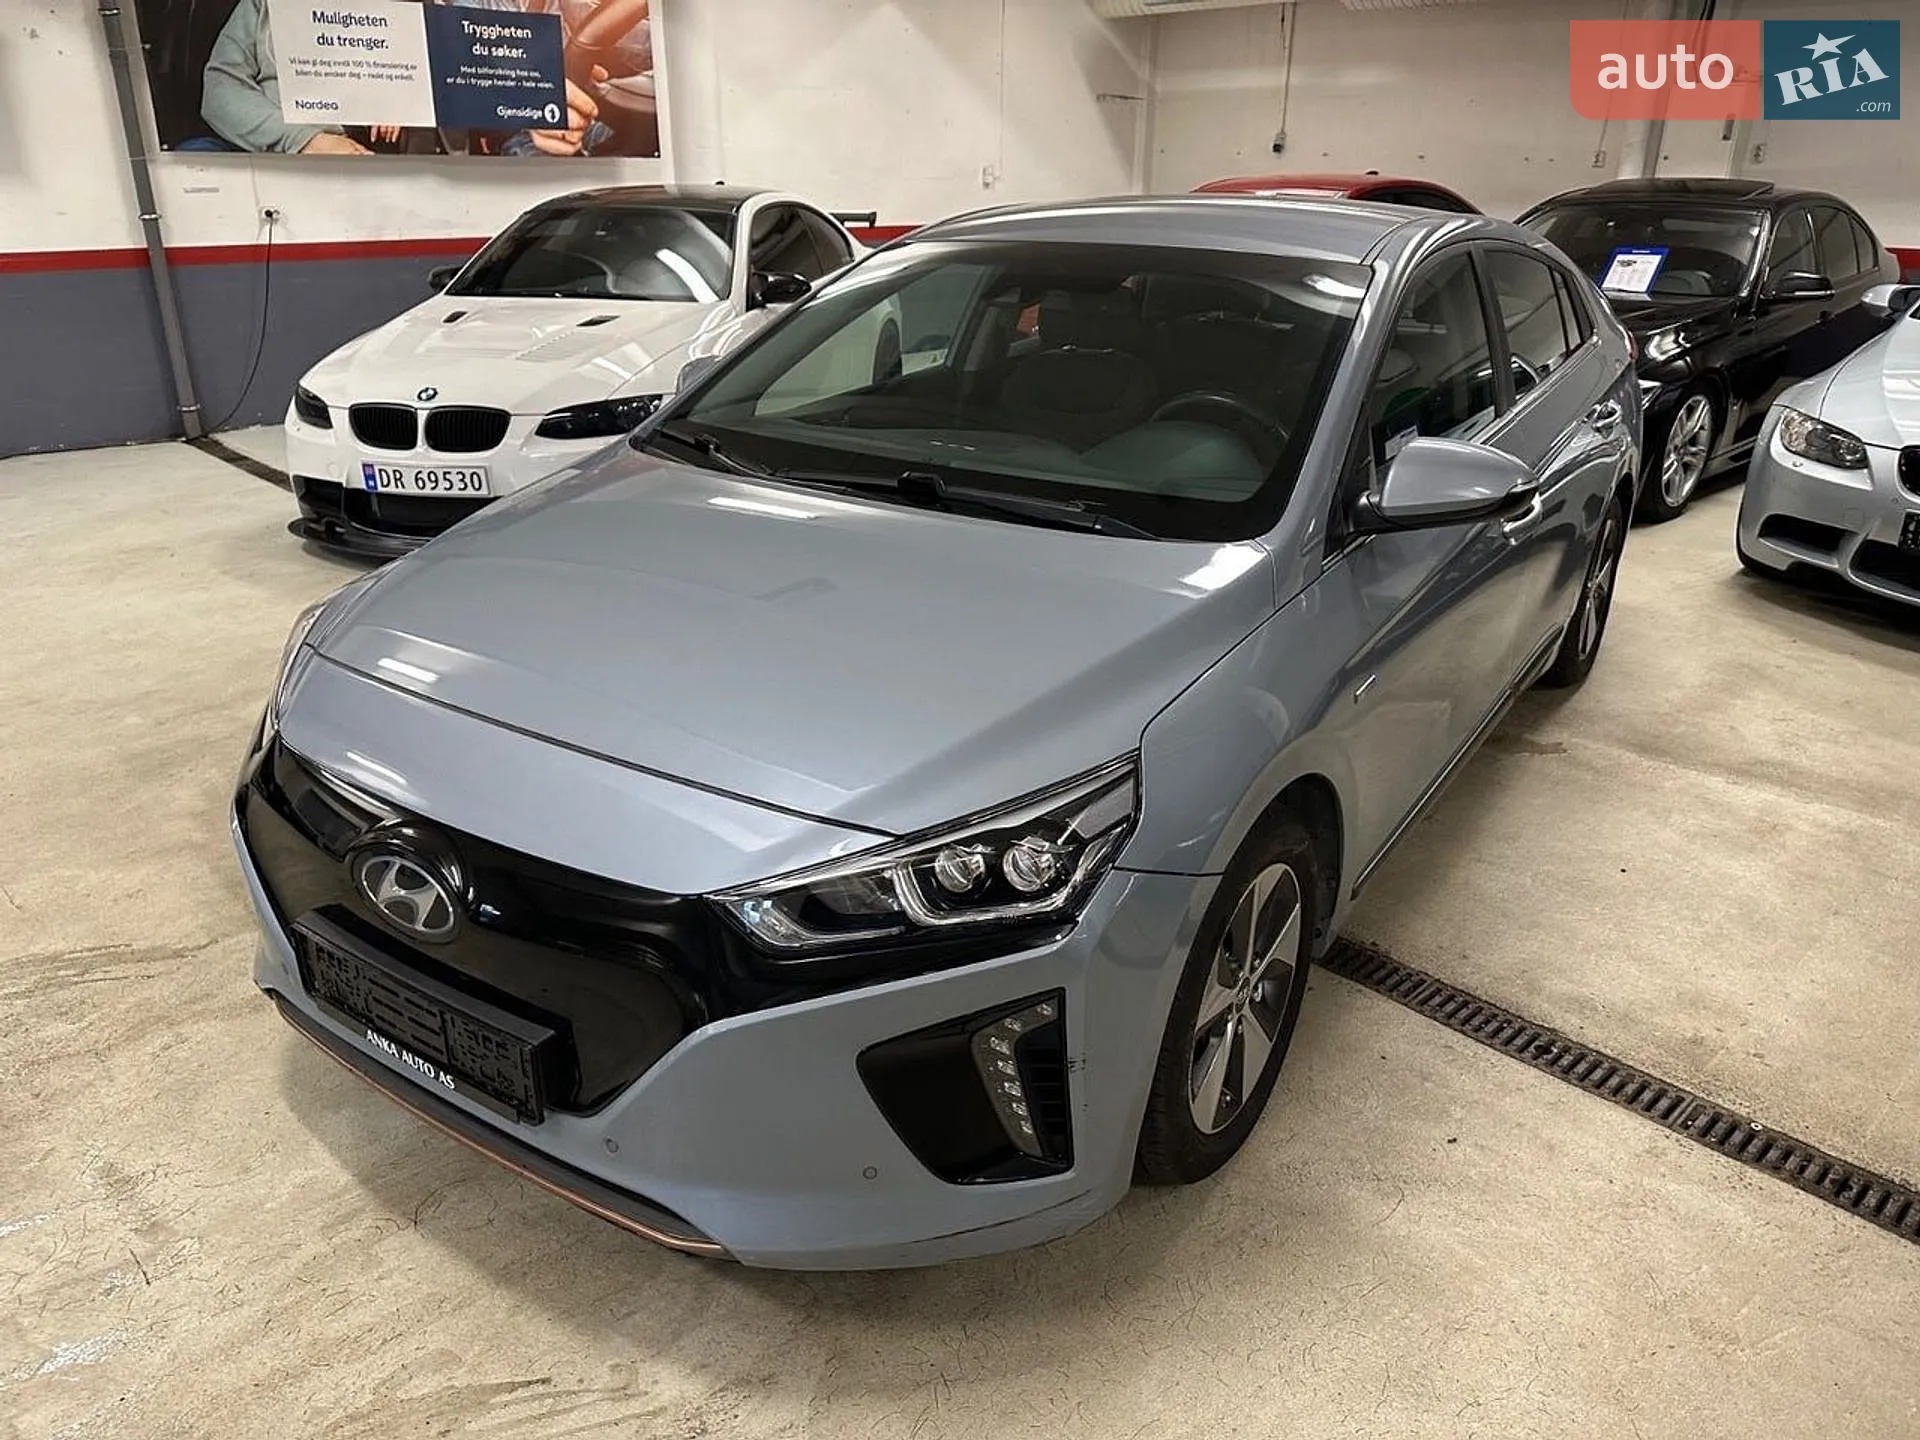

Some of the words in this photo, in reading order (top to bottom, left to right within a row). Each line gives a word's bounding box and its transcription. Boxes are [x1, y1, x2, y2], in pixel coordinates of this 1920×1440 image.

[311, 10, 388, 28] Muligheten
[461, 20, 532, 39] Tryggheten
[316, 33, 335, 46] du
[337, 34, 389, 50] trenger.
[472, 42, 489, 55] du
[491, 44, 527, 58] søker.
[295, 100, 339, 111] Nordea
[496, 105, 543, 120] Gjensidige
[378, 468, 405, 489] DR
[414, 470, 482, 492] 69530
[367, 1029, 399, 1058] ANKA
[402, 1050, 434, 1078] AUTO
[439, 1071, 455, 1089] AS
